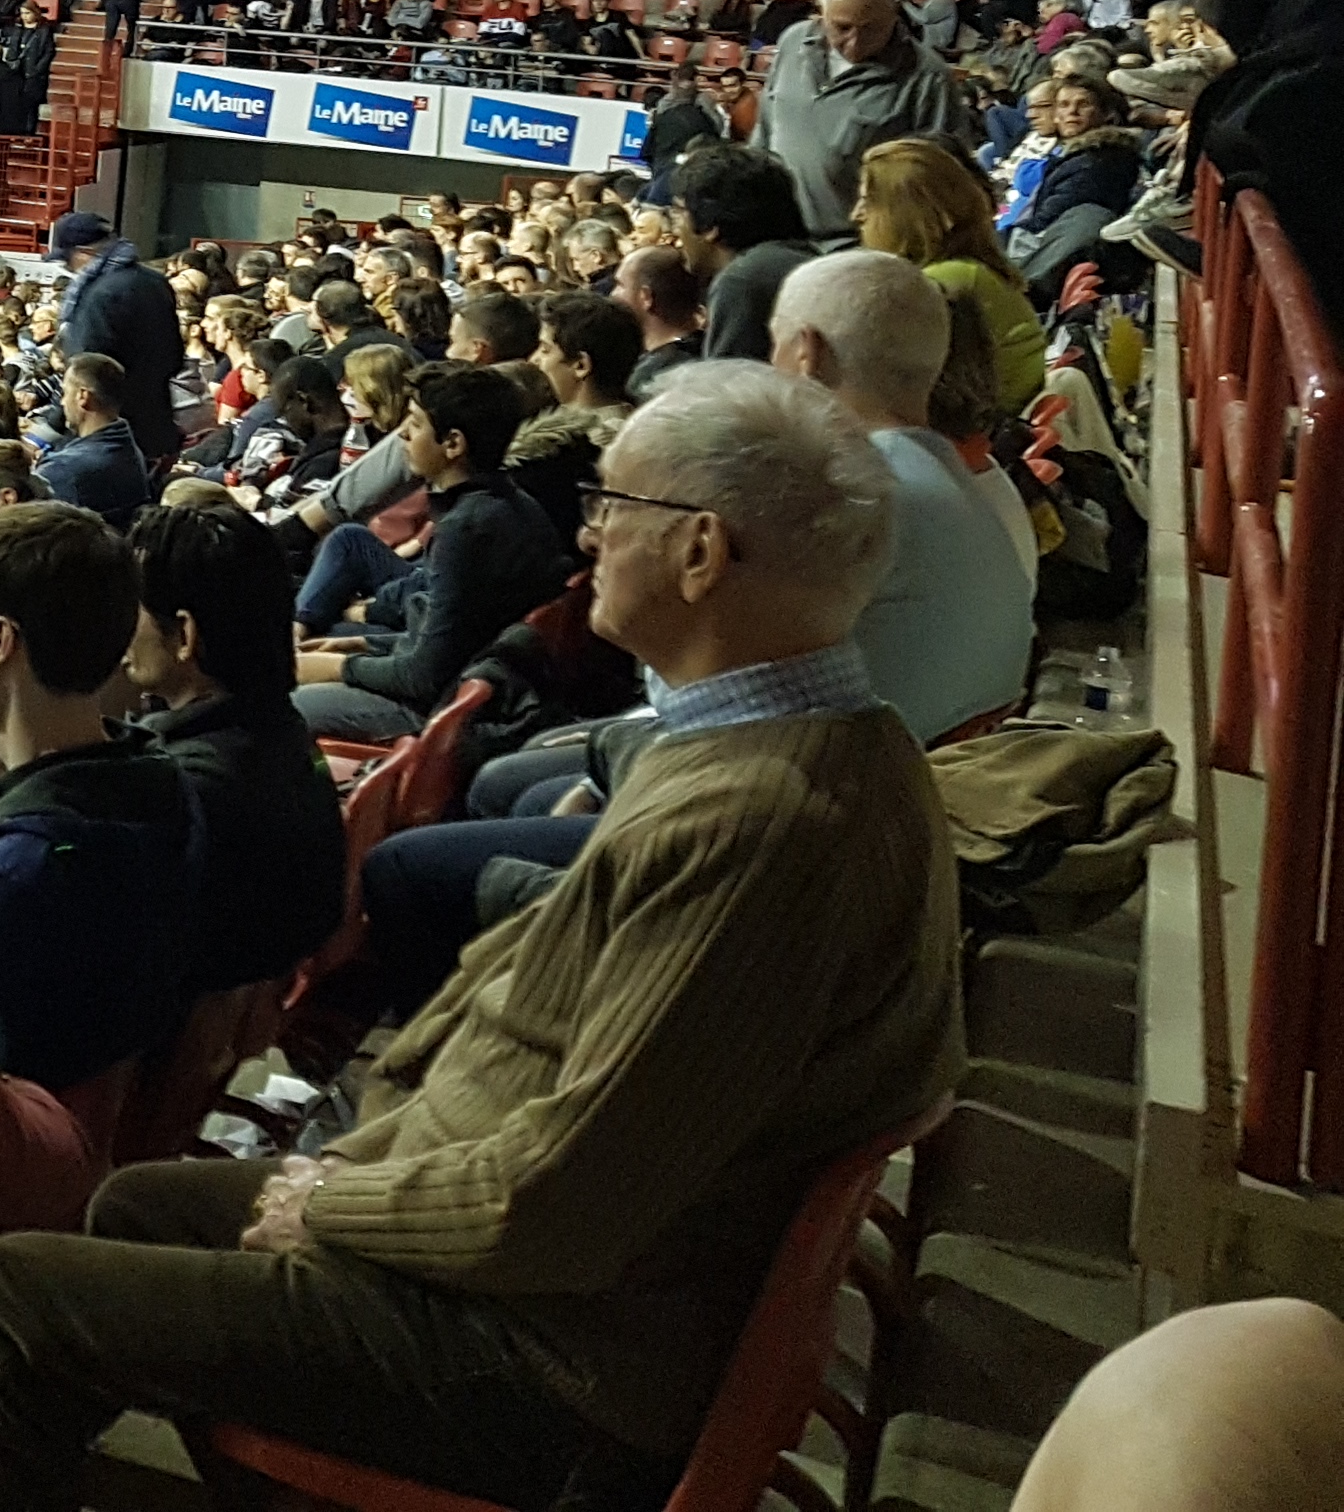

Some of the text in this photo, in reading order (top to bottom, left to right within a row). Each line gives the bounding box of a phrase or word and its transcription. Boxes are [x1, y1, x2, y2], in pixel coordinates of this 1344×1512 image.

[176, 88, 266, 115] Le Maine
[315, 100, 408, 127] Le Maine
[470, 114, 569, 143] Le Maine
[624, 133, 643, 148] Le
